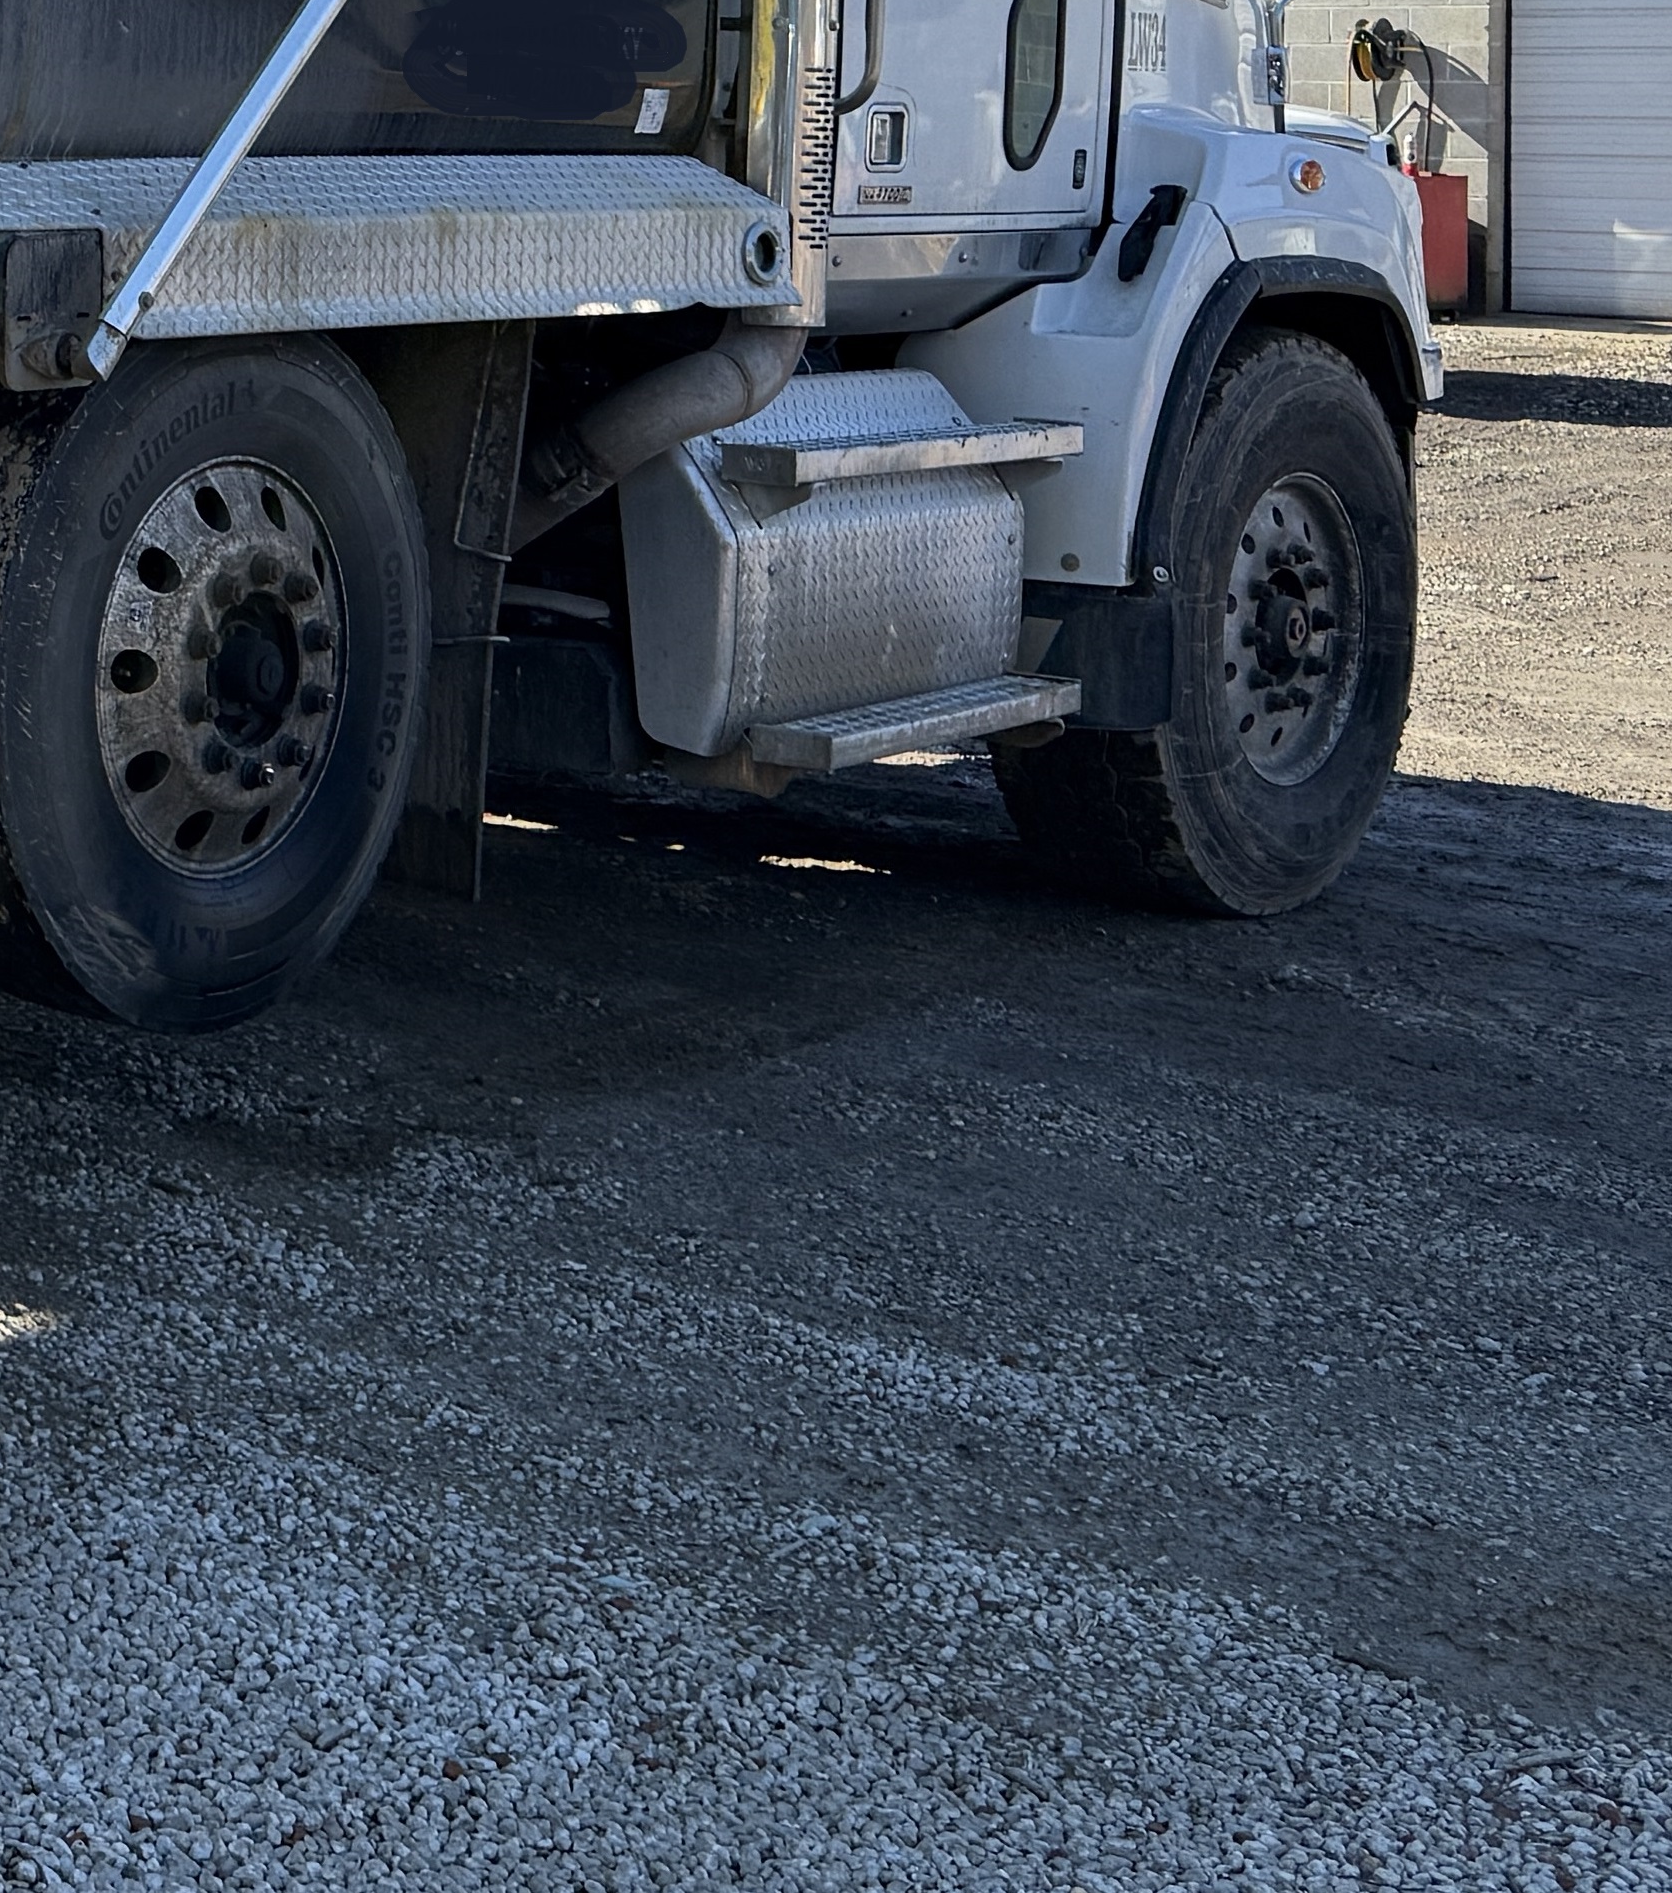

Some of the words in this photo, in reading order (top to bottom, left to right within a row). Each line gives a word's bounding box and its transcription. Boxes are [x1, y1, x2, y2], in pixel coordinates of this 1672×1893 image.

[1127, 12, 1167, 72] LW34
[99, 380, 237, 541] Continental
[383, 550, 409, 655] Conti
[376, 672, 407, 757] HSC
